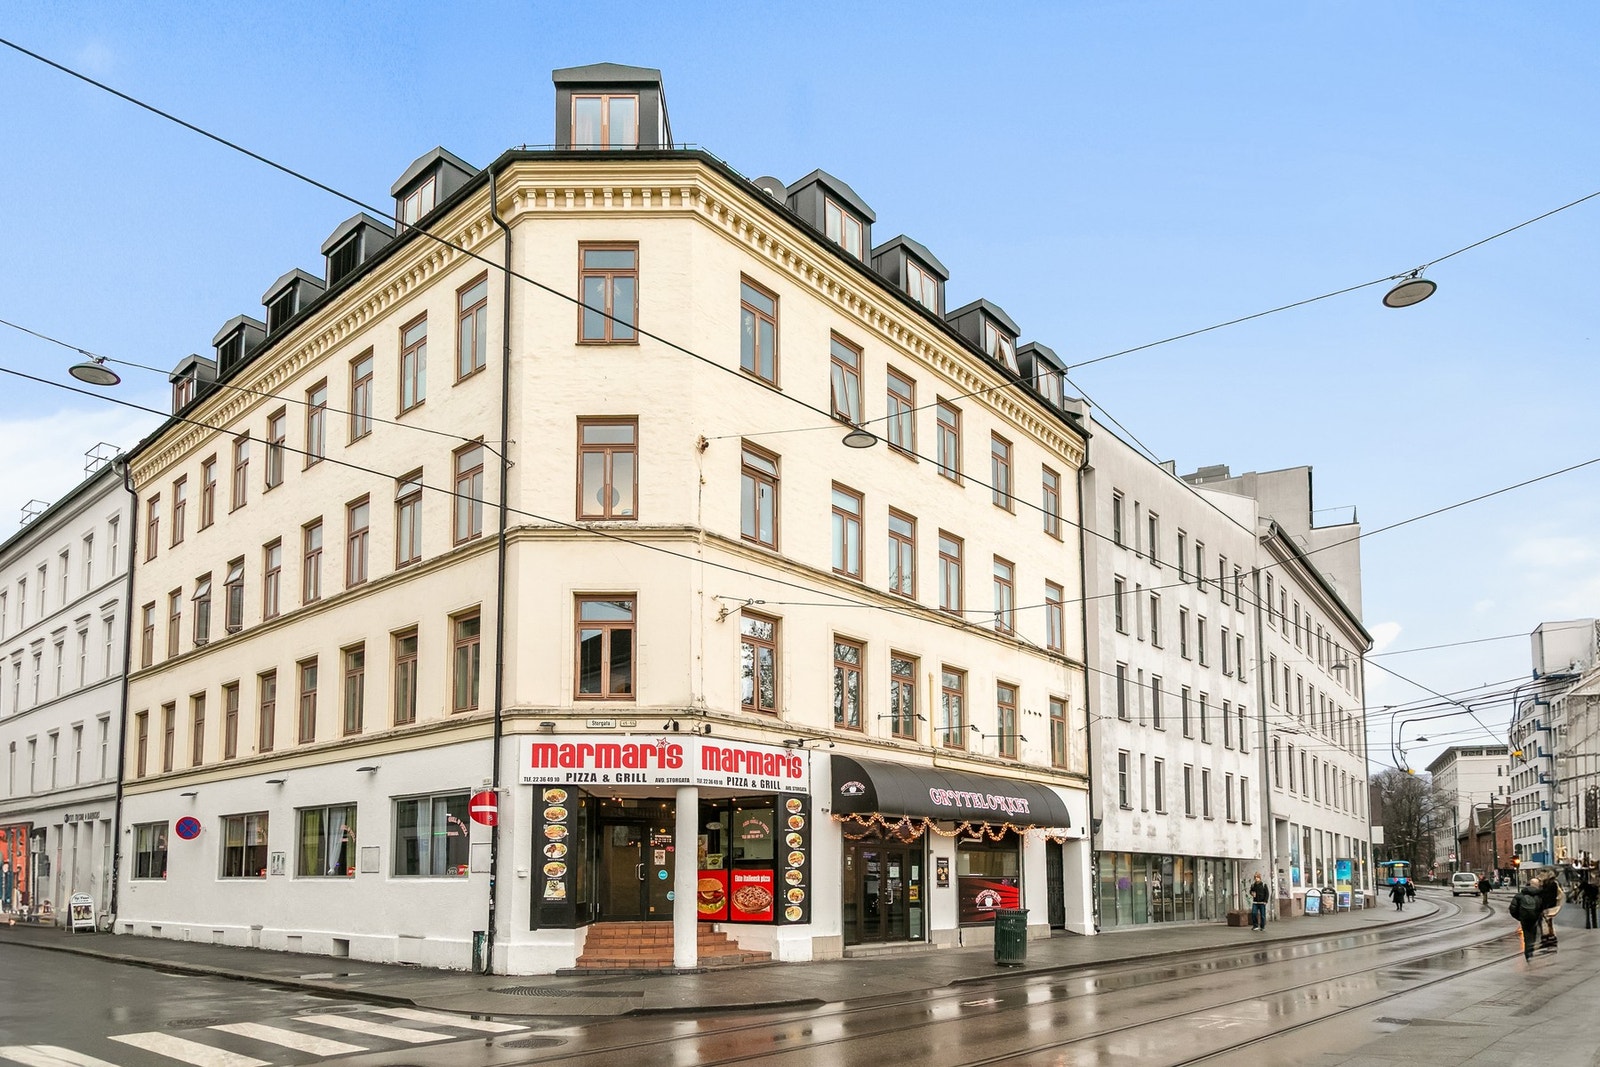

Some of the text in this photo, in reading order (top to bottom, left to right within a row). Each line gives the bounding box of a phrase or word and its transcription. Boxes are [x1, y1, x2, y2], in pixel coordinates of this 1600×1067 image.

[565, 772, 647, 783] PIZZA & GRILL
[726, 776, 781, 790] PIZZA & GRILL
